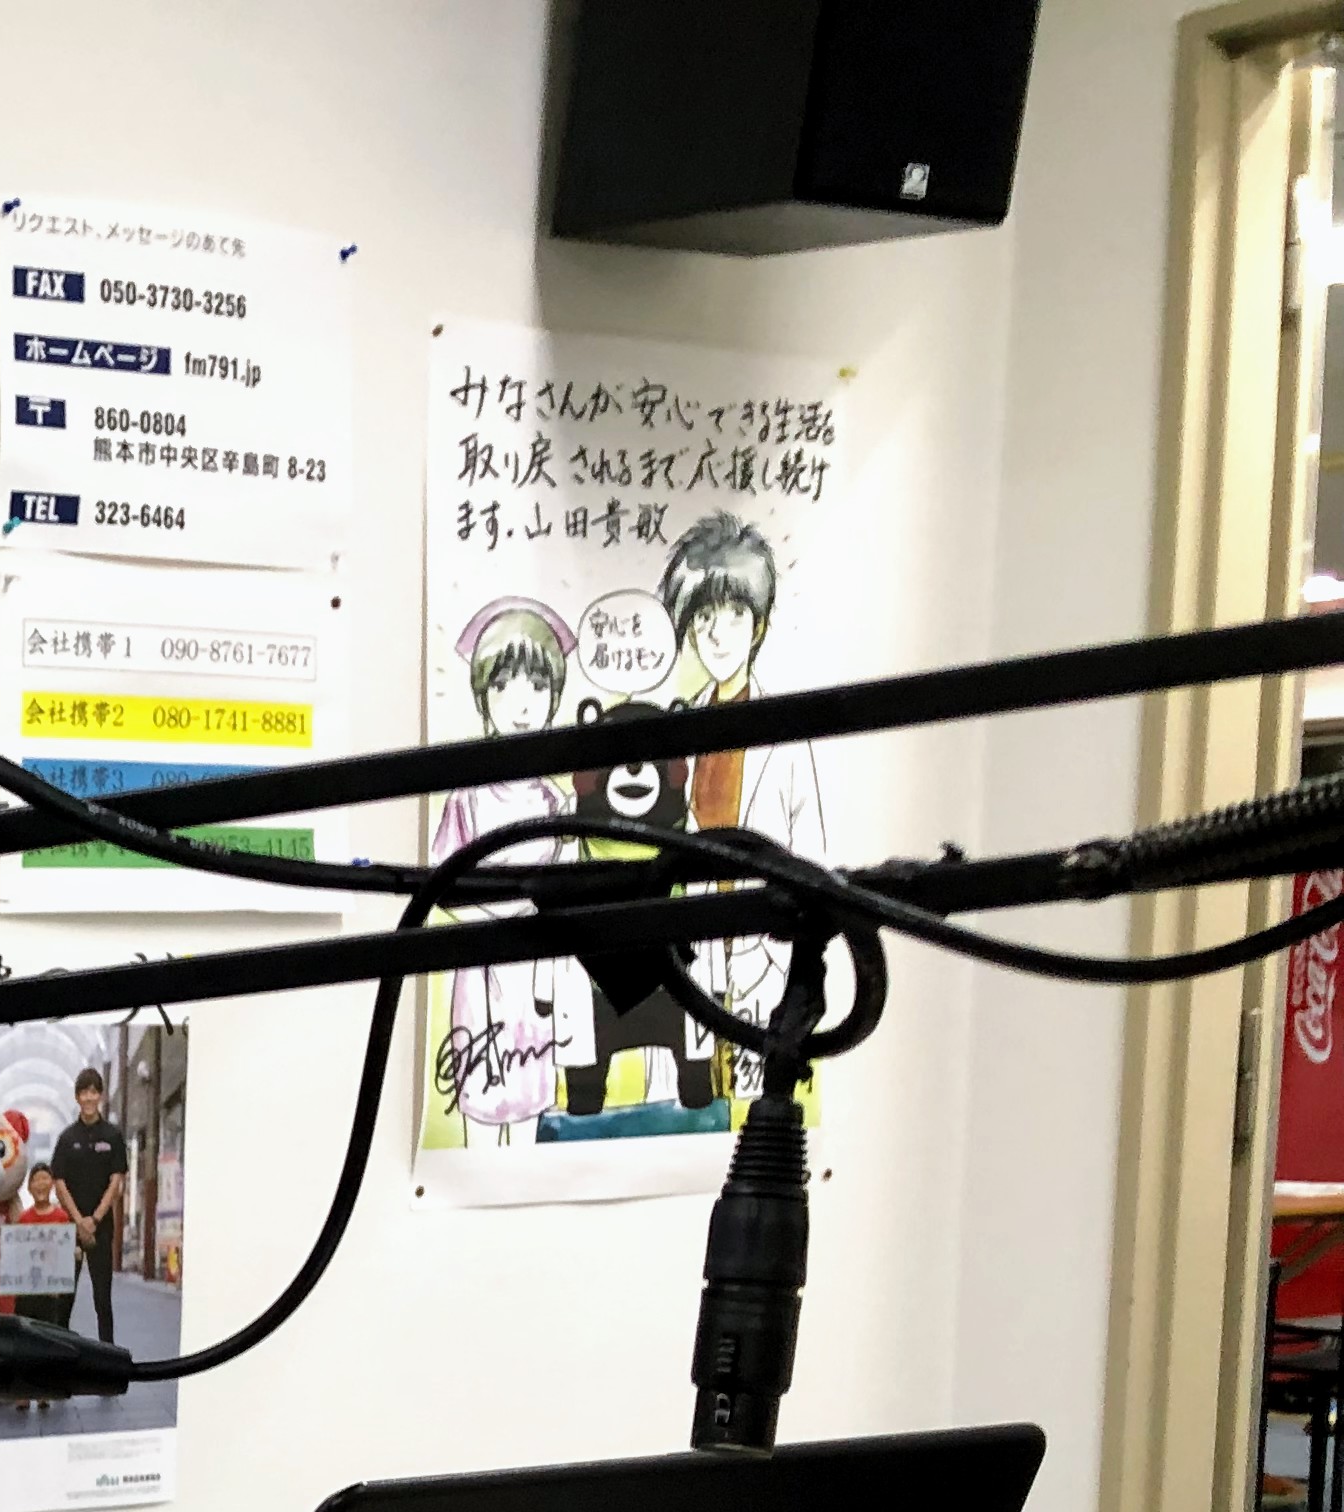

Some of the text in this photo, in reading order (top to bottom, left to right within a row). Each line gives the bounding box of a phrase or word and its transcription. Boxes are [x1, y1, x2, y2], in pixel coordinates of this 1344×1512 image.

[26, 271, 247, 319] FAX 050-3730-3256
[26, 335, 262, 388] ホームページ fm791.jp
[94, 407, 187, 437] 860-0804
[287, 457, 327, 482] 8-23
[24, 495, 186, 530] TEL 323-6464
[161, 638, 312, 668] 090-8761-7677
[153, 706, 307, 736] 080-1741-8881
